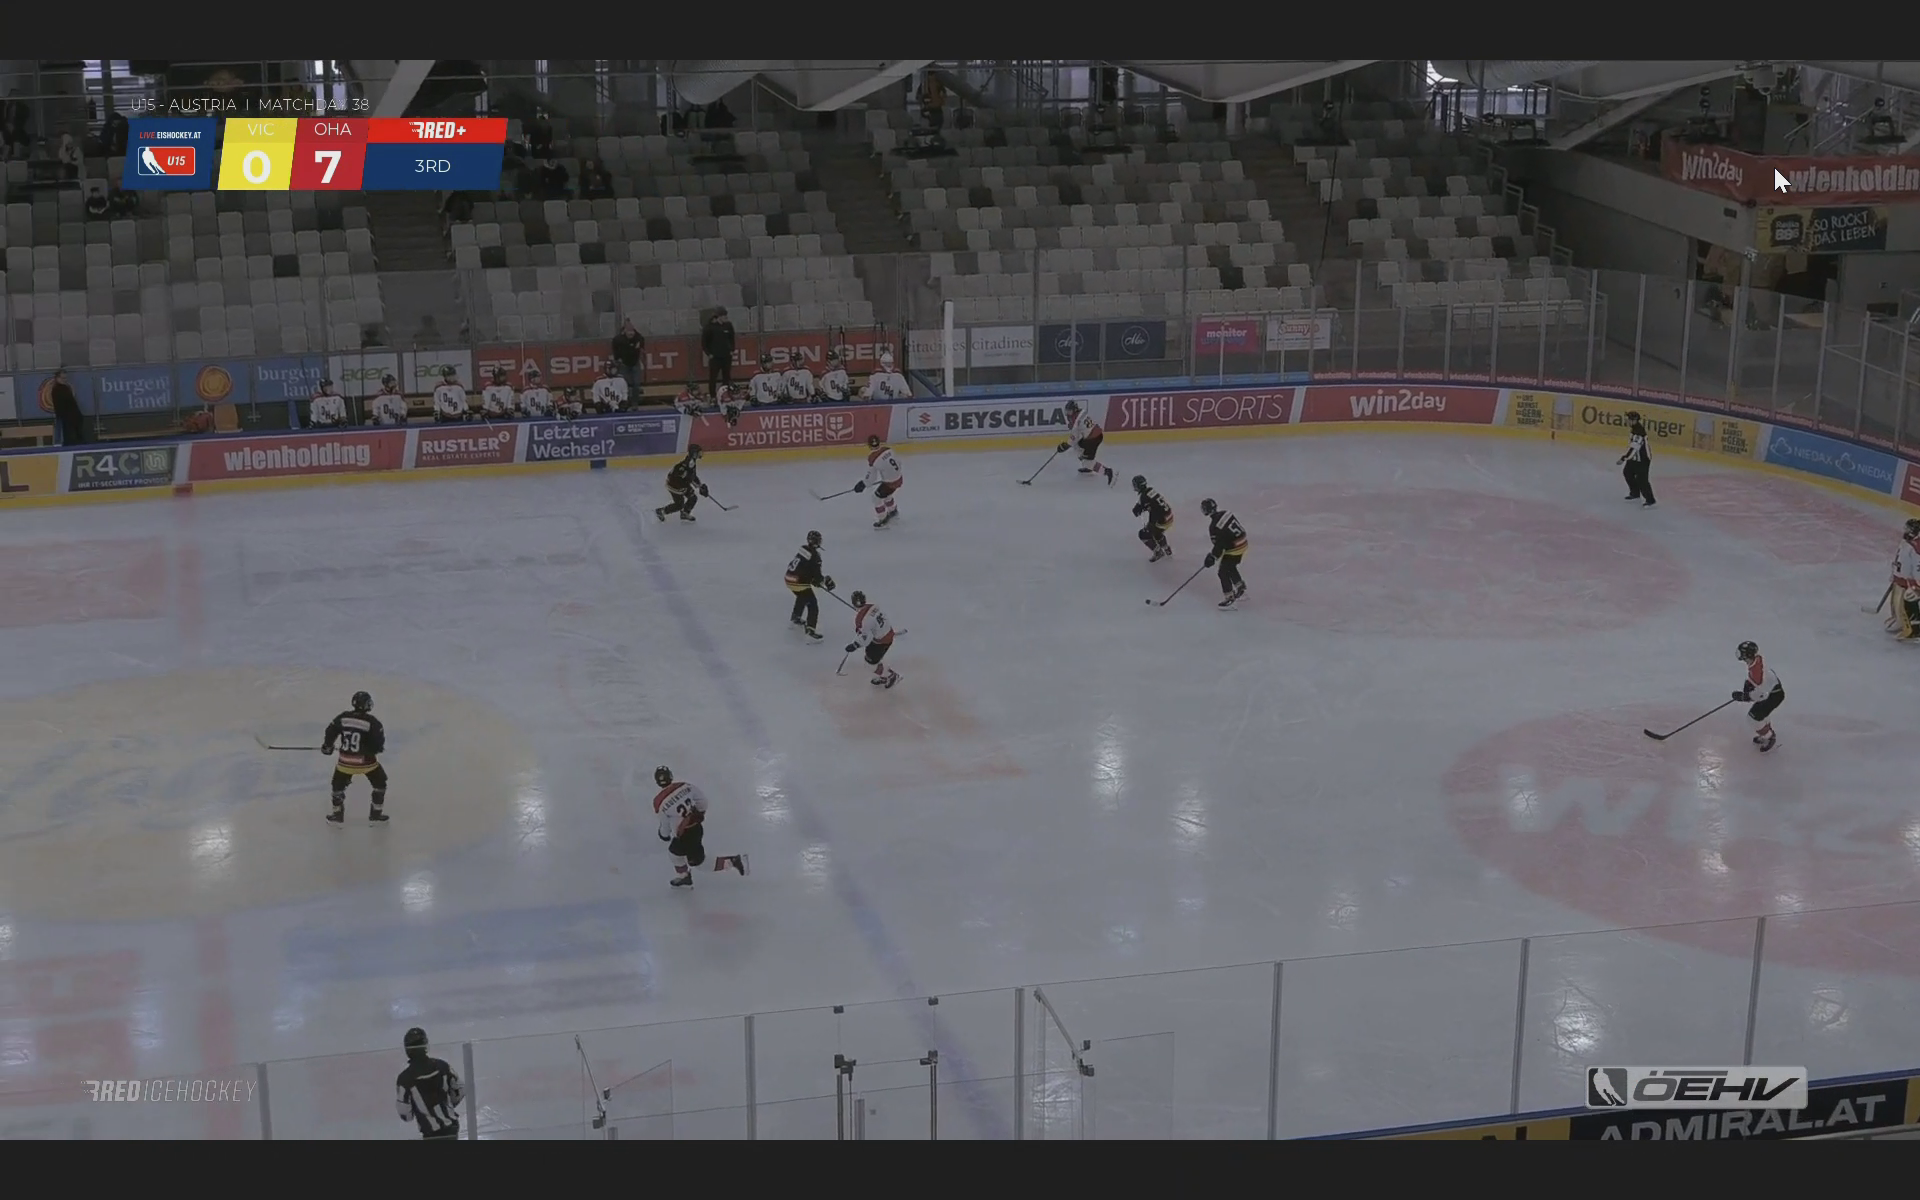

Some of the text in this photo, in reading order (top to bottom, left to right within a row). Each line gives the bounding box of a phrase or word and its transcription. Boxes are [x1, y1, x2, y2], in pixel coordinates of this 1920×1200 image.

[1832, 211, 1869, 229] ROCKT
[1815, 224, 1876, 246] DAS LEBEN
[971, 335, 1034, 352] citadines
[258, 365, 321, 382] burgen
[102, 376, 170, 393] burgen
[128, 392, 171, 410] land
[1350, 389, 1446, 418] win2day
[944, 407, 1067, 430] BEYSCHLA
[1121, 394, 1284, 428] STEFFL SPORTS
[759, 413, 823, 429] WIENER
[911, 425, 940, 433] SUZUKI
[533, 424, 598, 441] Letzter
[727, 427, 824, 446] STÄDTISCHE
[422, 437, 500, 454] RUSTLER
[533, 440, 616, 458] Wechsel?
[889, 458, 899, 471] 9
[1794, 446, 1834, 466] NIEDAX
[76, 454, 141, 478] R4C
[1857, 463, 1893, 482] NIEDAX
[78, 481, 91, 489] IHR
[92, 478, 132, 488] IT-SECURITY
[342, 731, 361, 752] 59
